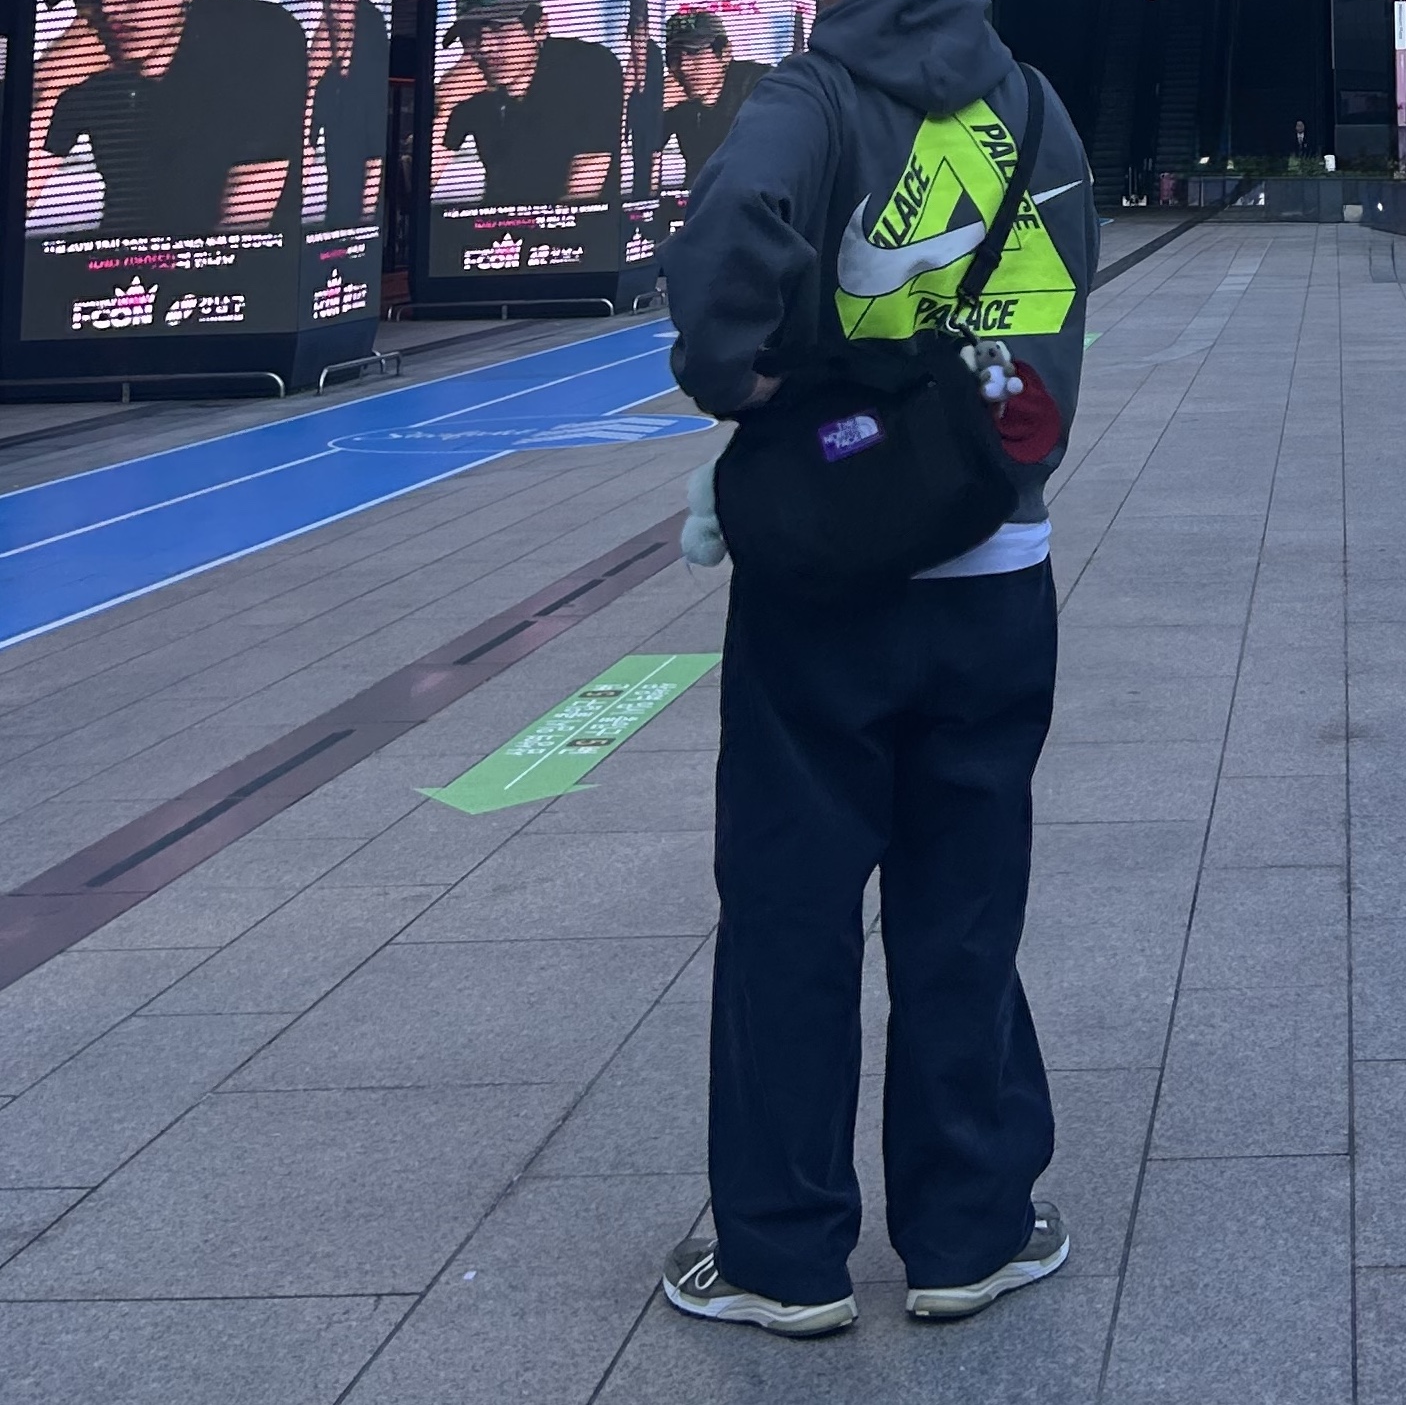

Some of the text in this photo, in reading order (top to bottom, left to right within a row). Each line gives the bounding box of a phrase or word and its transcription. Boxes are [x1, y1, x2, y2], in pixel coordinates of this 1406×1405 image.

[871, 154, 930, 249] ALACE
[970, 123, 1040, 231] PALCE
[914, 296, 1019, 331] PAACE
